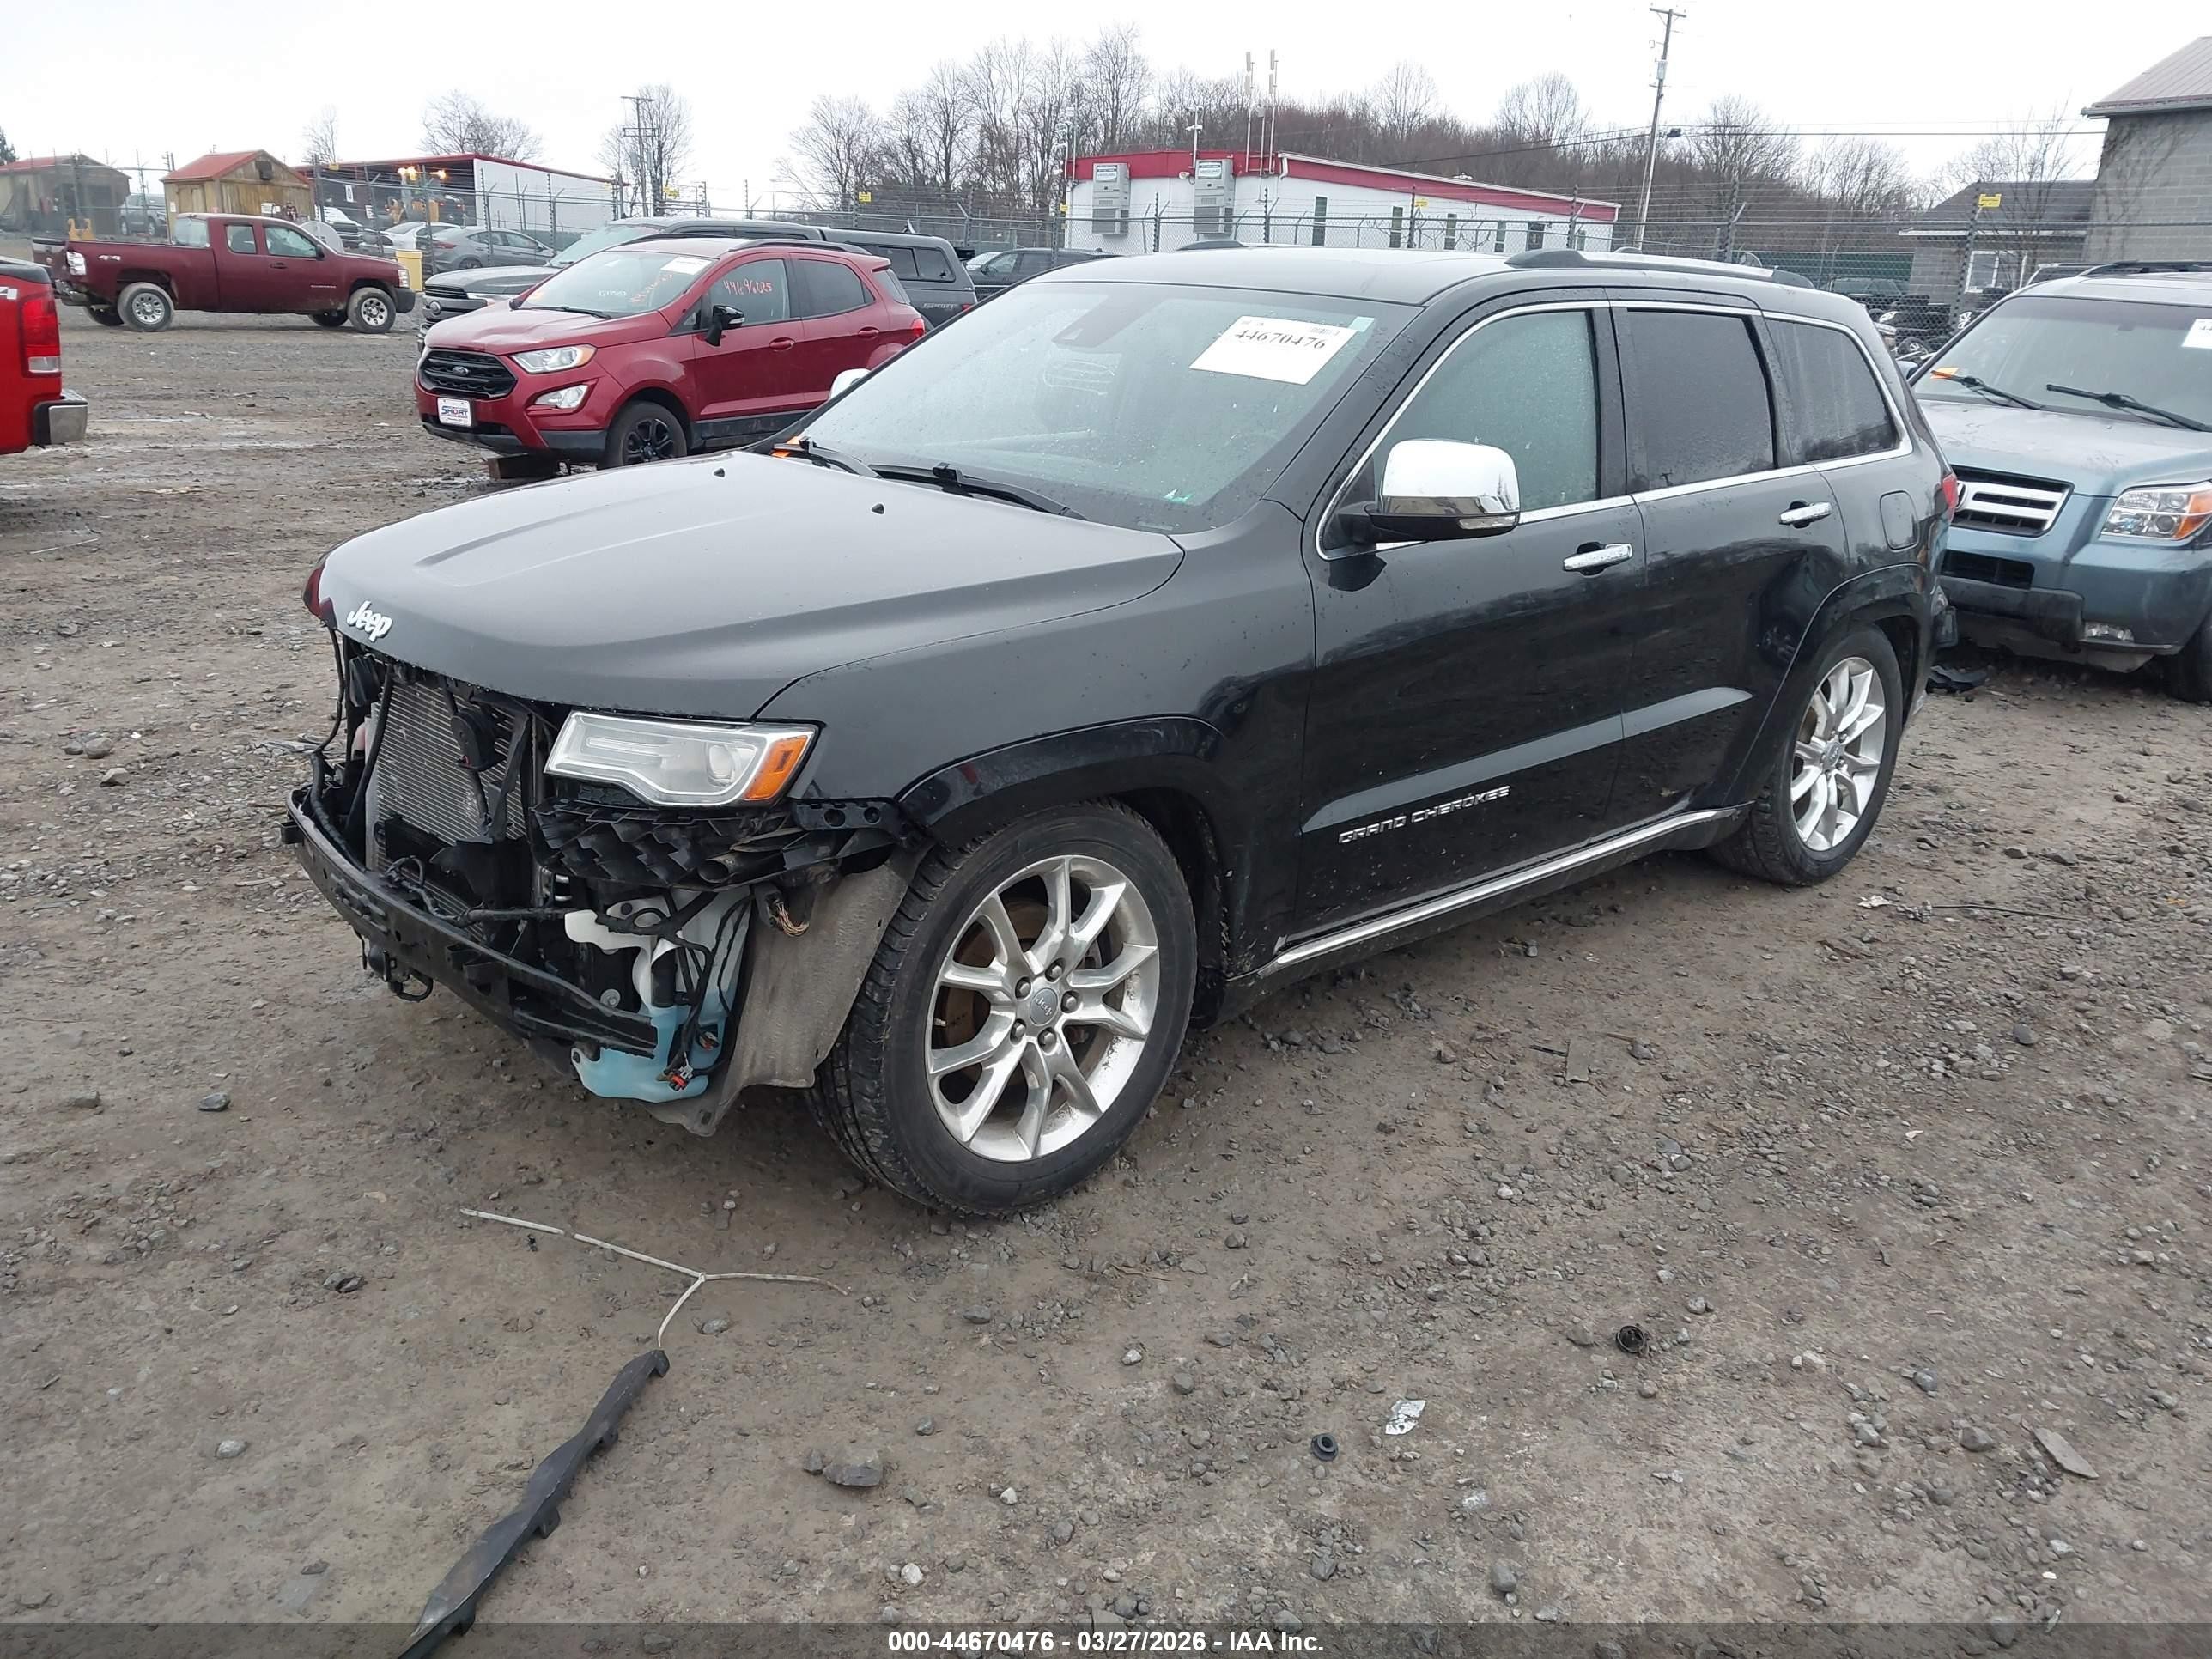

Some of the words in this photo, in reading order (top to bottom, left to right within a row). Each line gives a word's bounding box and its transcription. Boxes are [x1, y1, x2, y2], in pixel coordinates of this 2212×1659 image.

[1235, 329, 1326, 349] 44670476
[346, 600, 393, 642] Jeep
[1338, 815, 1407, 844] GRAND
[1411, 785, 1511, 823] CHEROKEE
